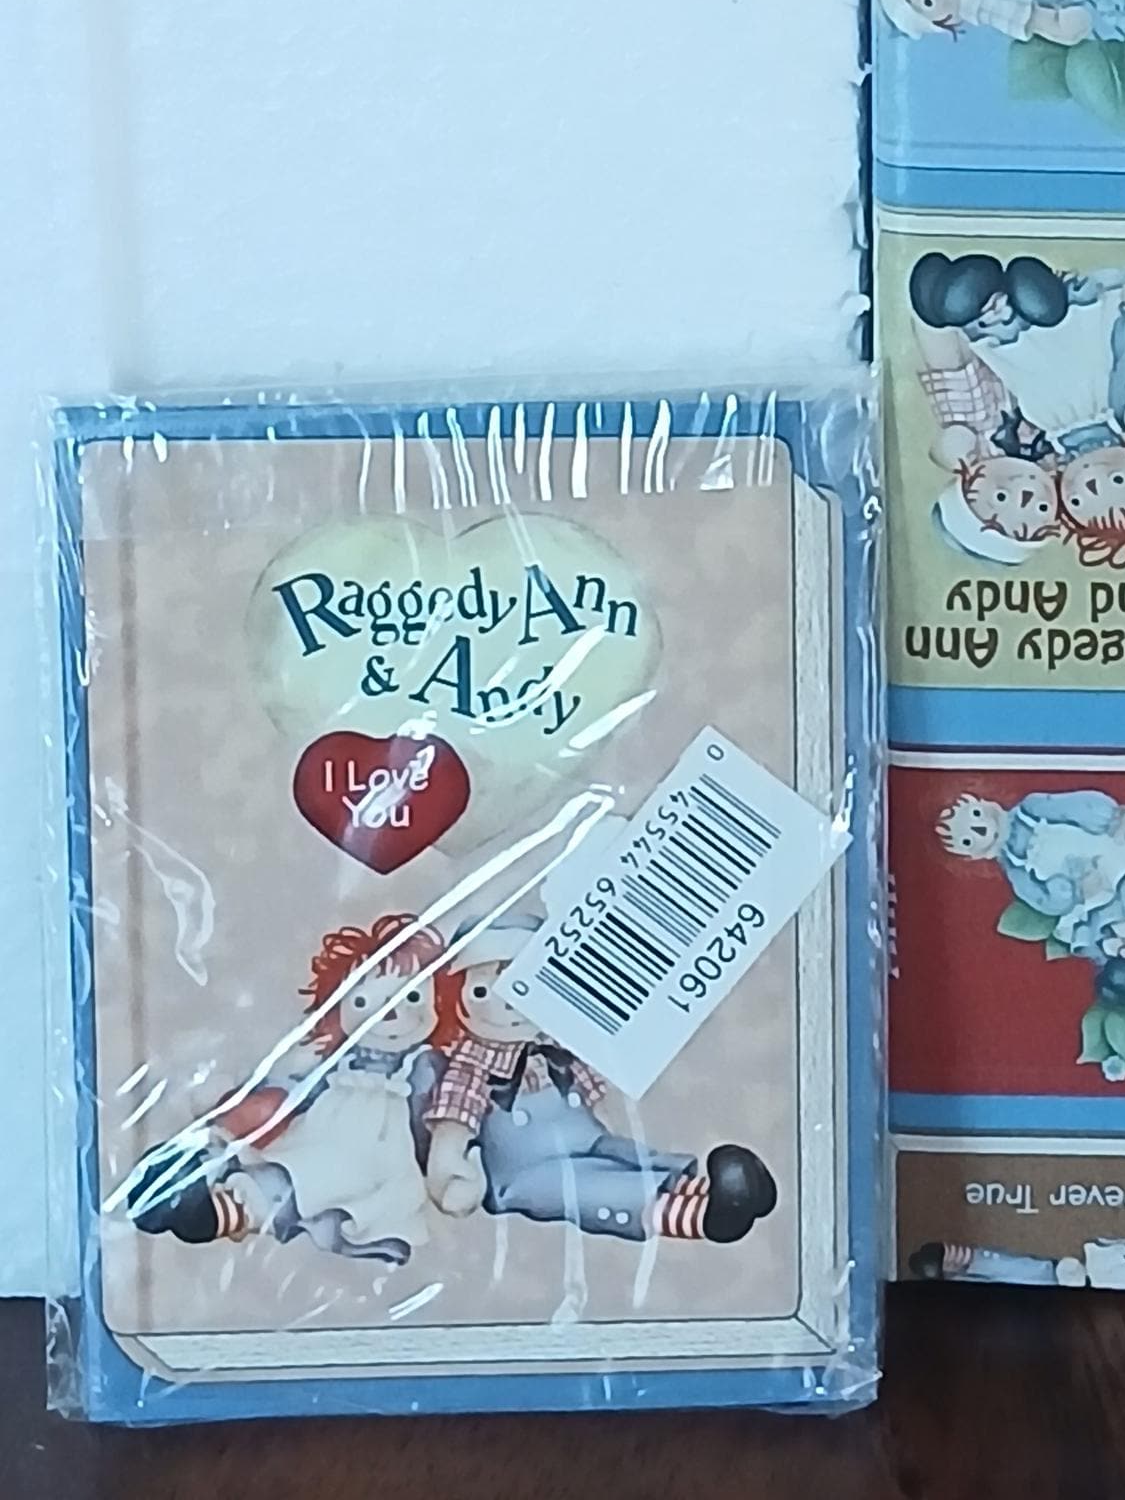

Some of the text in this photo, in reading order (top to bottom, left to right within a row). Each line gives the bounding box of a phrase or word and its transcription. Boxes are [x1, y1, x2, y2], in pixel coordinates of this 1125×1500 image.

[271, 564, 638, 657] Raggedy Ann
[946, 580, 1068, 621] Andy
[906, 626, 998, 668] Ann
[361, 635, 581, 735] & Andy
[325, 760, 429, 792] I Love
[342, 796, 409, 829] You
[620, 791, 690, 869] 45544
[545, 877, 616, 958] 65252
[668, 903, 766, 1013] 642061
[965, 1182, 1039, 1214] True
